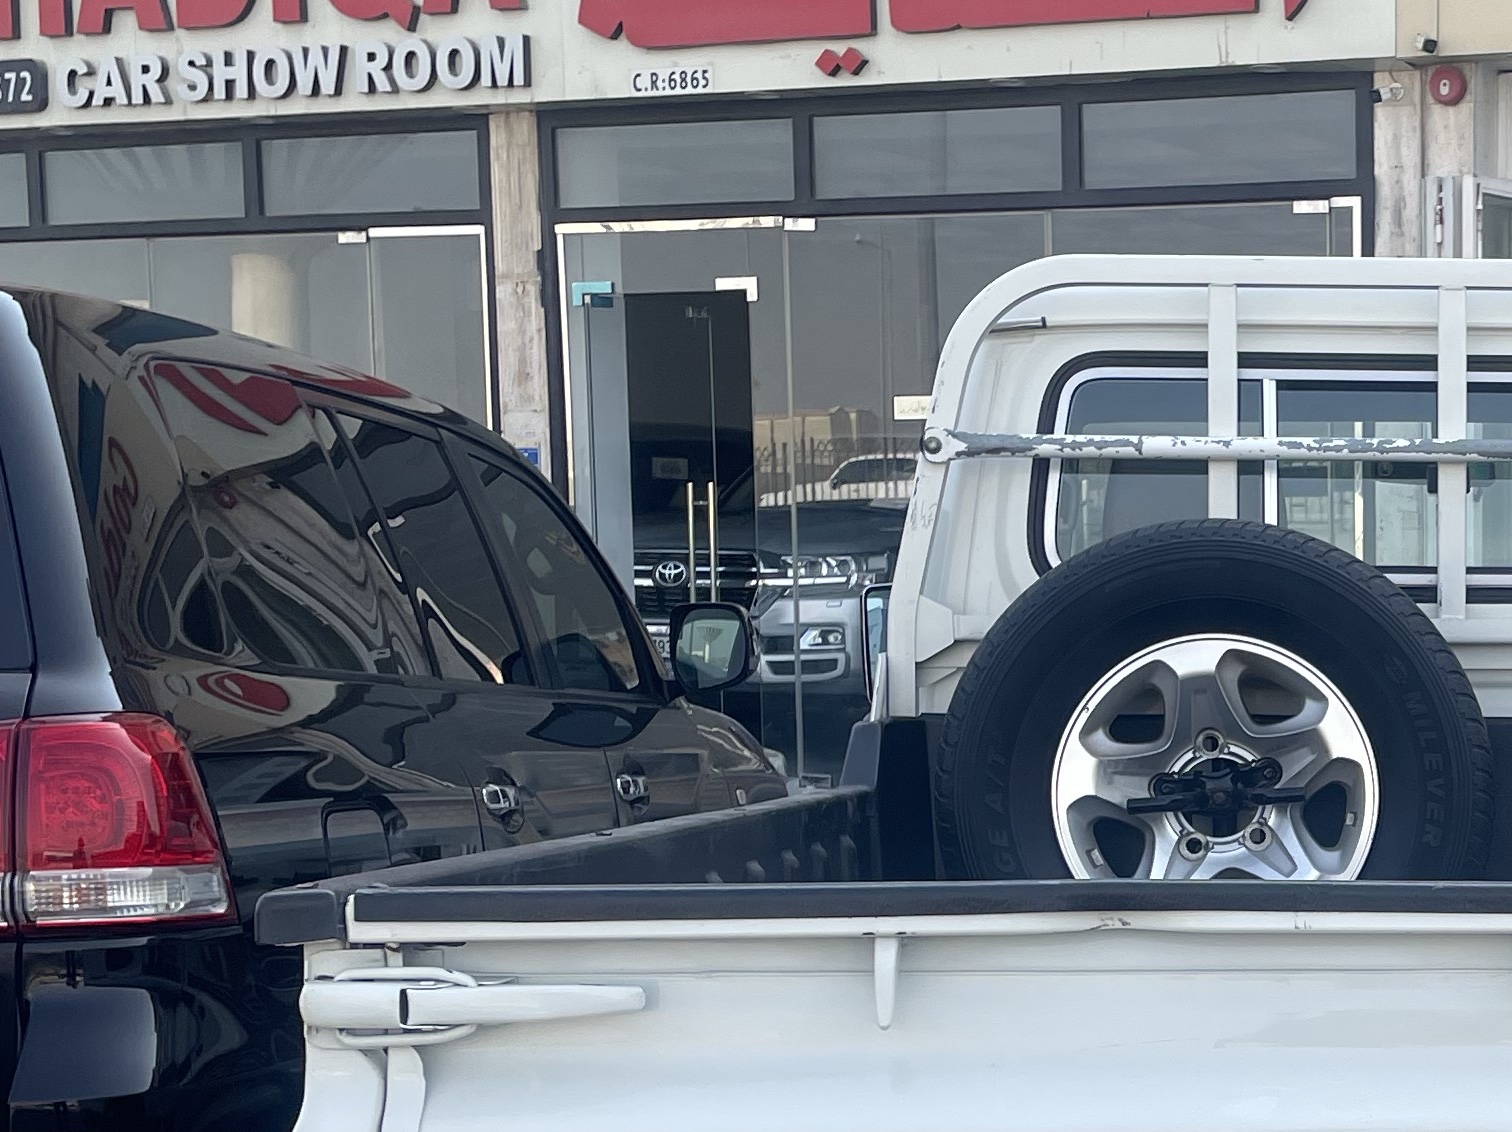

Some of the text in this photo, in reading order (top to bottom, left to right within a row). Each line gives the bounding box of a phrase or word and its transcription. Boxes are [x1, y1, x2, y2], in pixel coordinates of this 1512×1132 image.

[0, 70, 33, 103] 72
[56, 34, 529, 108] CAR SHOW ROOM
[632, 69, 709, 92] C.R:6865
[1402, 690, 1445, 849] MILEVER
